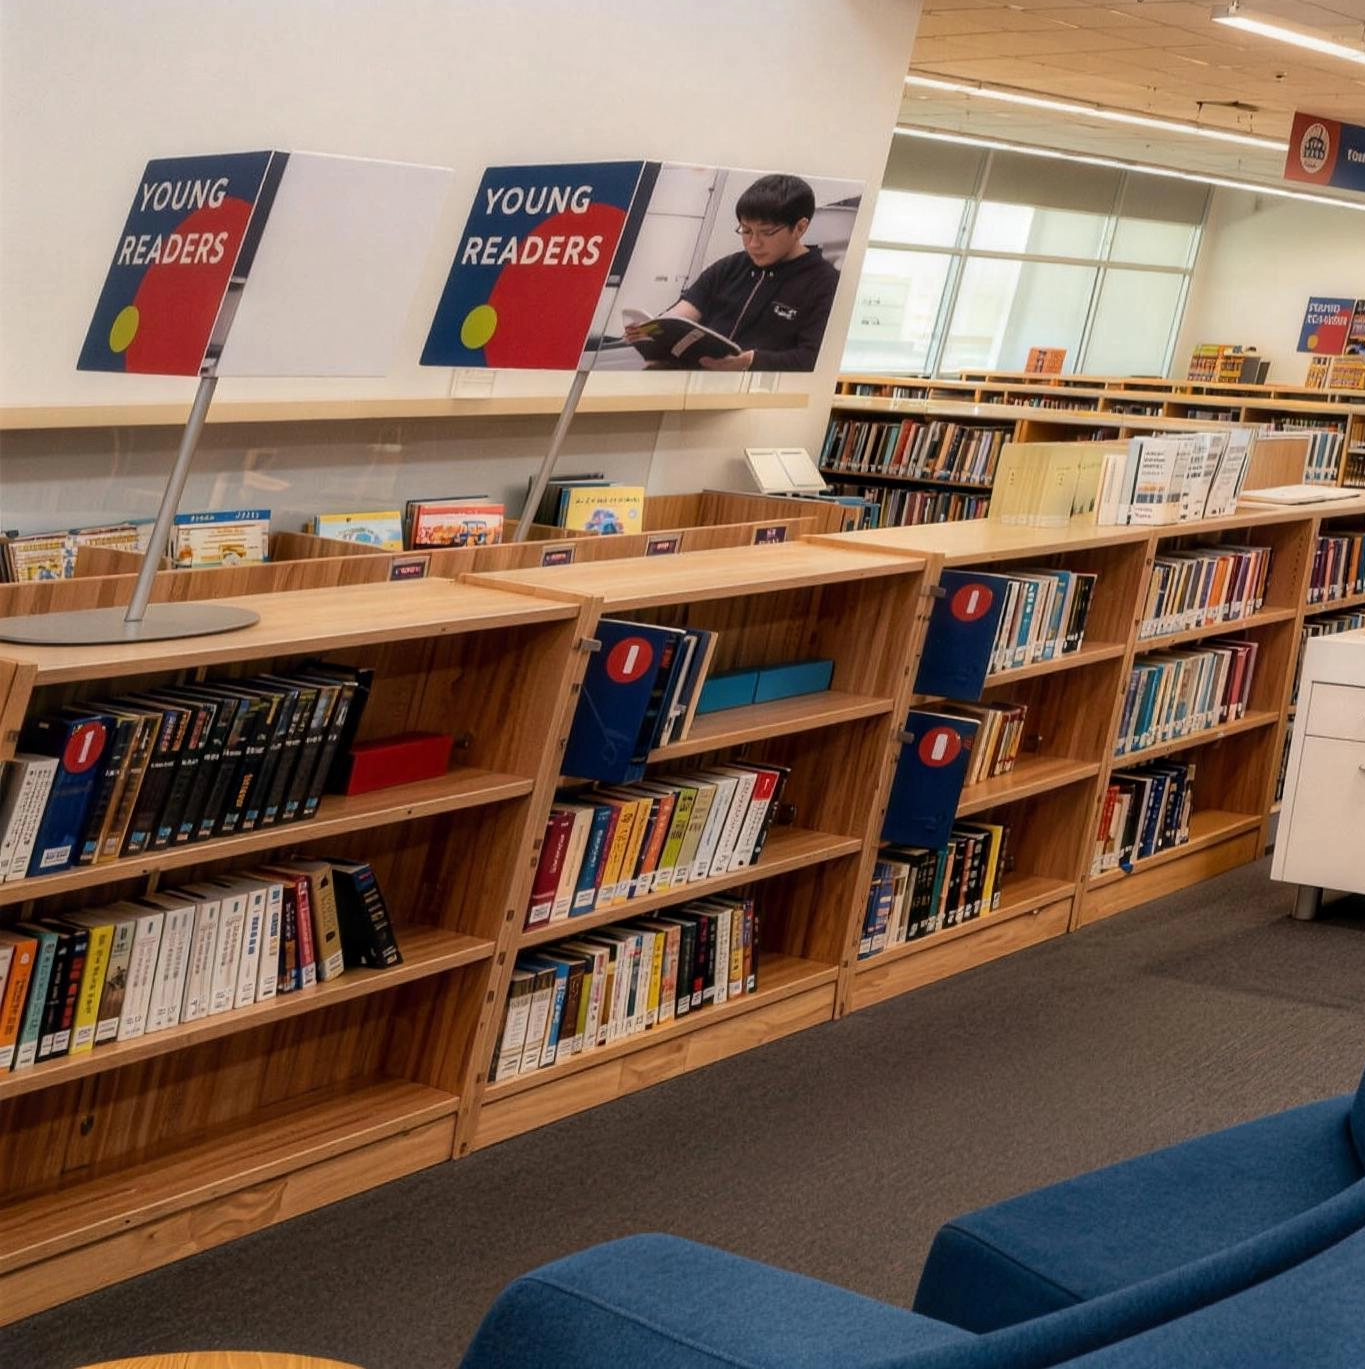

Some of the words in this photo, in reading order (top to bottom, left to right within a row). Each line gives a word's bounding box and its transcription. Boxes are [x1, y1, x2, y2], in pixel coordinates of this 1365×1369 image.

[140, 177, 229, 212] YOUNG
[485, 185, 593, 215] YOUNG
[117, 231, 229, 265] READERS
[461, 235, 603, 266] READERS
